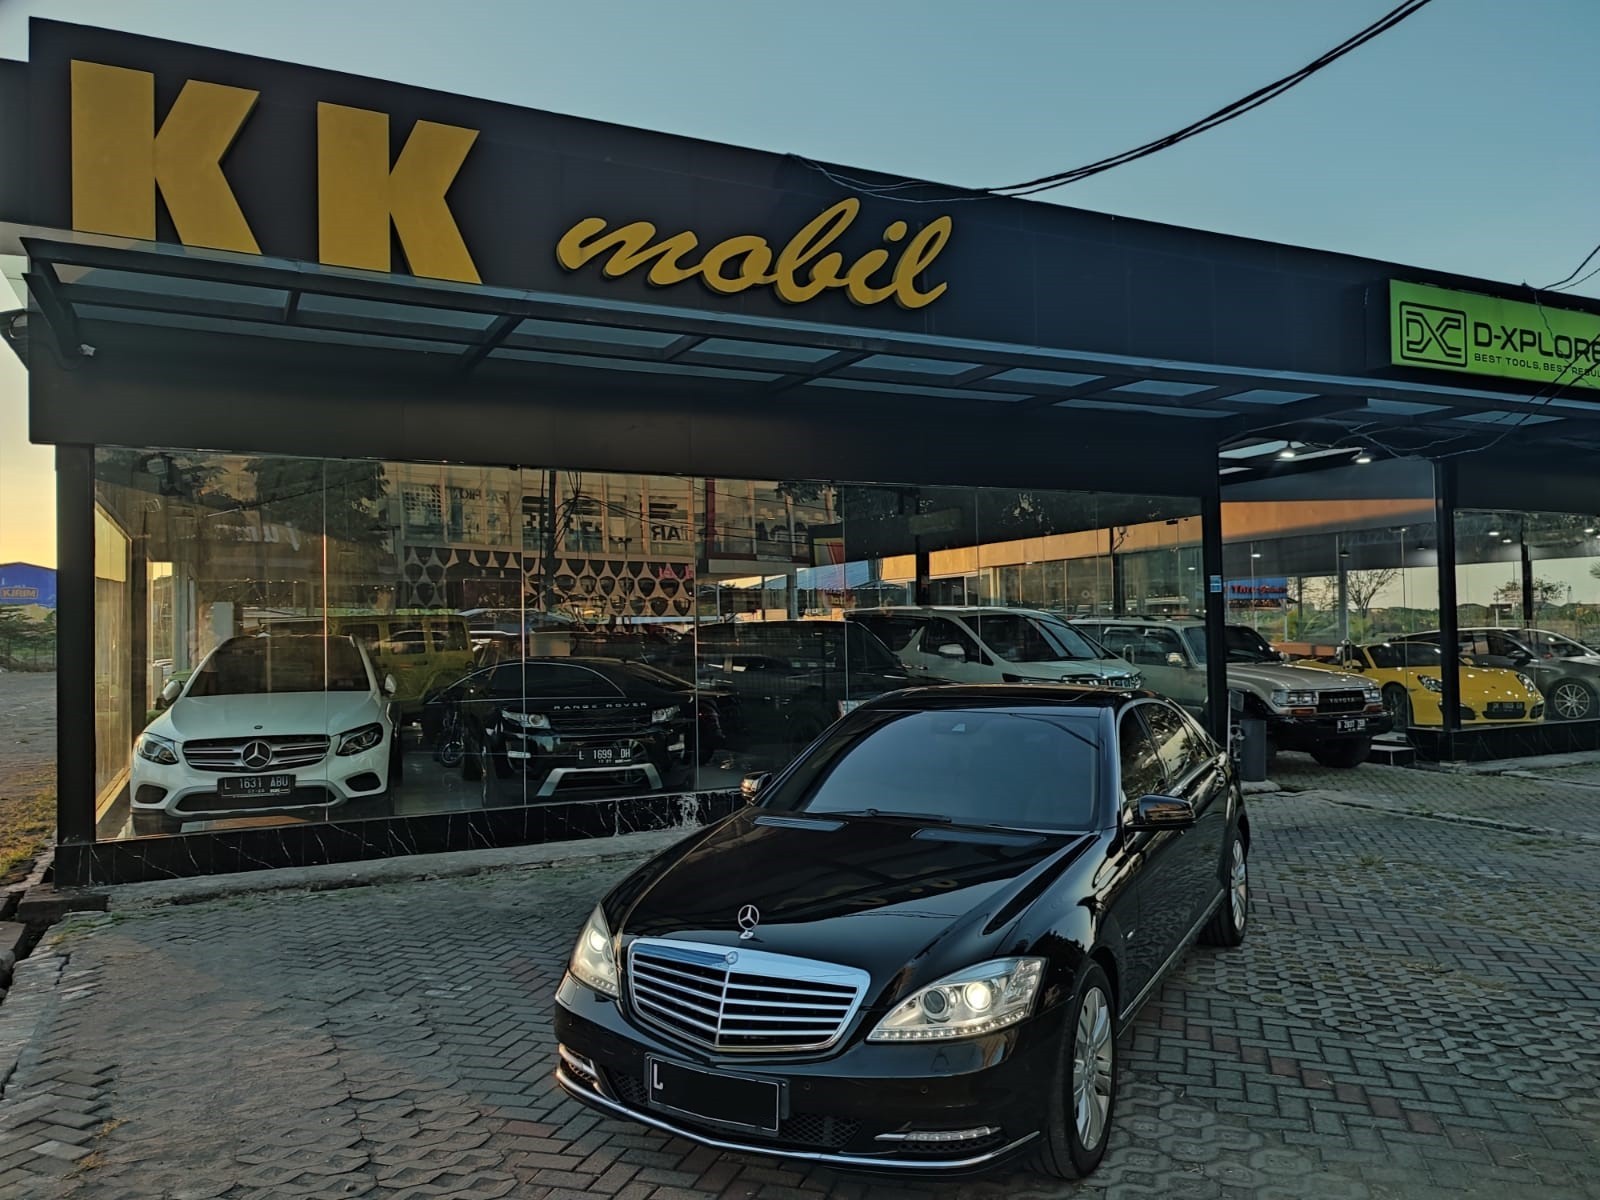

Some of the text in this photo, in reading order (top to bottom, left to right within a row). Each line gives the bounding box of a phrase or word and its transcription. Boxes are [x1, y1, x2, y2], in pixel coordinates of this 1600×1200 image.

[556, 197, 952, 309] mobil
[1474, 352, 1502, 363] BEST
[1505, 357, 1542, 371] TOOLS,
[1543, 362, 1568, 373] BEST
[578, 748, 631, 760] L 1699 DH
[224, 775, 289, 790] L 1631 ABU
[653, 1063, 664, 1090] L
